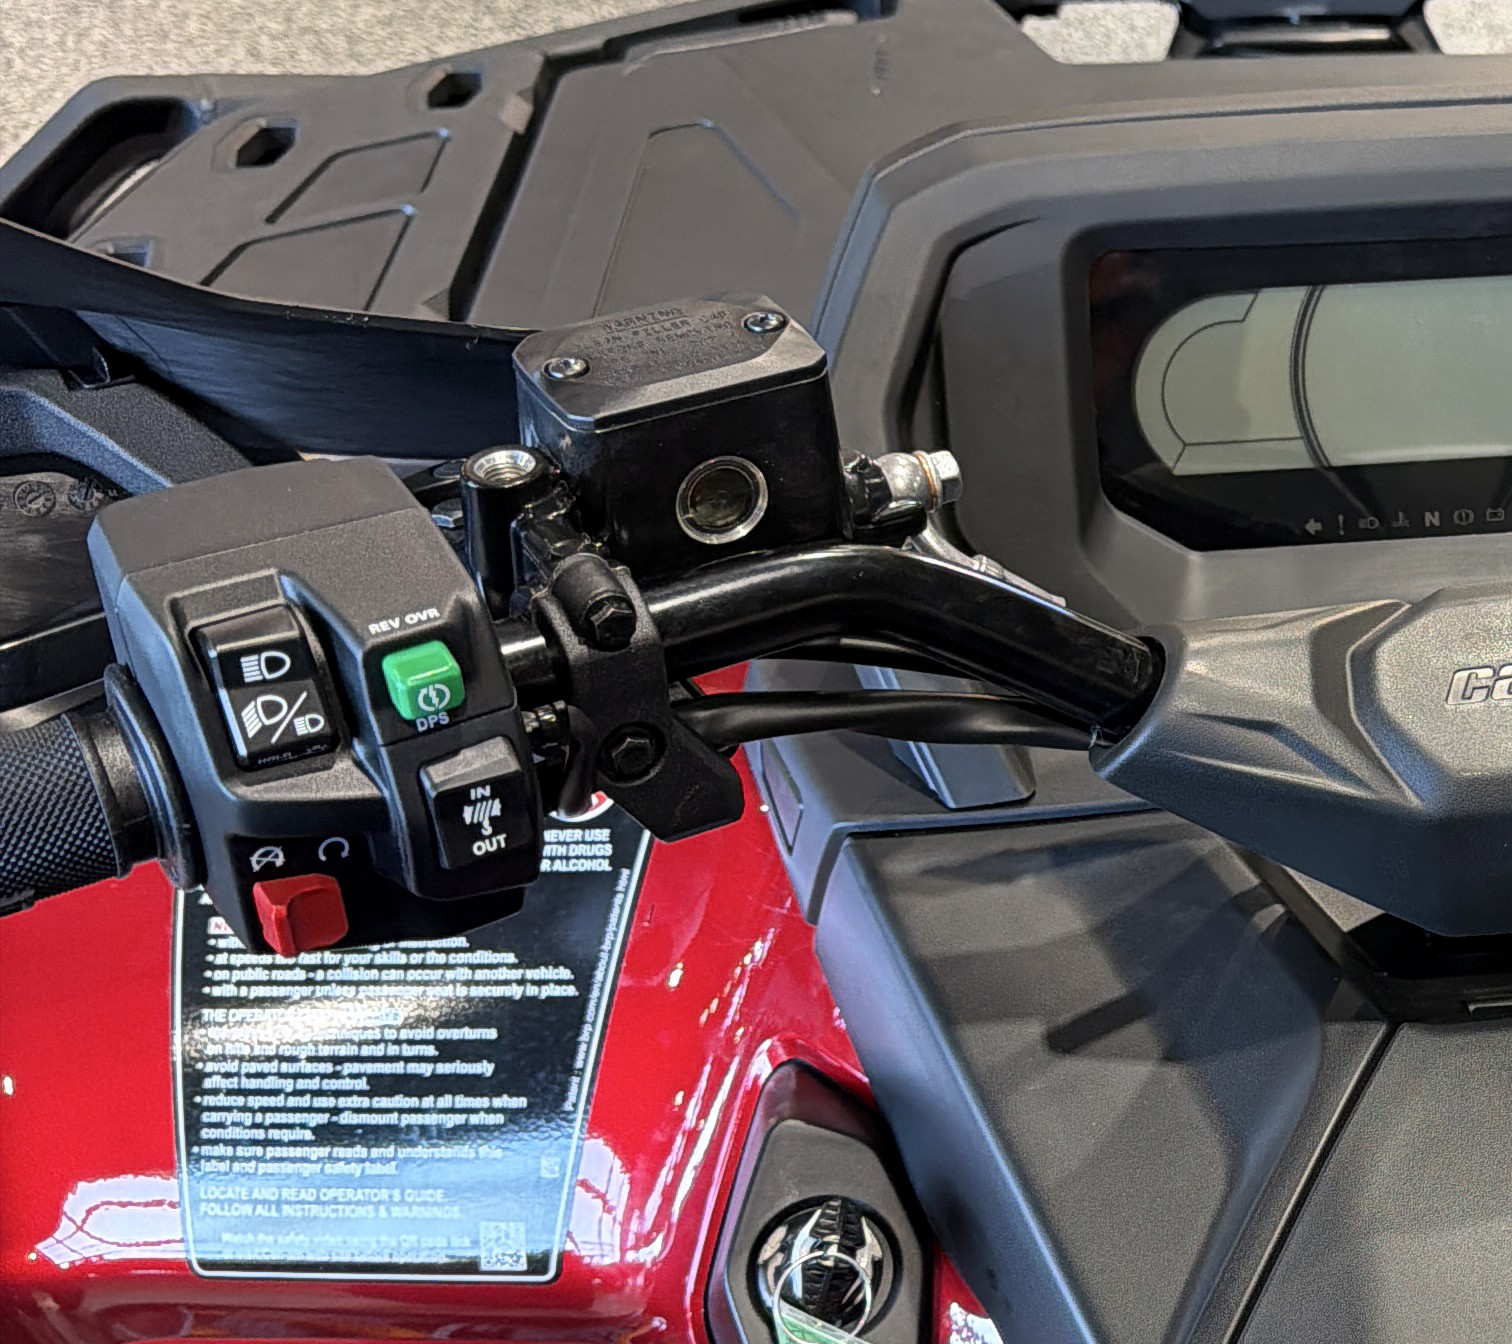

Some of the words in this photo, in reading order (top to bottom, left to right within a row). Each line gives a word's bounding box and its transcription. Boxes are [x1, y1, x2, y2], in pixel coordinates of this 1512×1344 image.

[1424, 510, 1441, 527] N
[368, 616, 400, 635] REV
[404, 608, 440, 627] OVR
[416, 712, 450, 733] DPS
[470, 785, 491, 801] IN
[585, 828, 611, 842] USE
[473, 834, 507, 856] OUT
[568, 843, 613, 857] DRUGS
[540, 859, 552, 872] R
[553, 859, 613, 872] ALCOHOL
[203, 1060, 239, 1073] avoid
[239, 1060, 278, 1077] paved
[279, 1060, 334, 1073] surfaces
[340, 1060, 405, 1076] pavement
[404, 1062, 435, 1077] may
[434, 1060, 495, 1077] seriously
